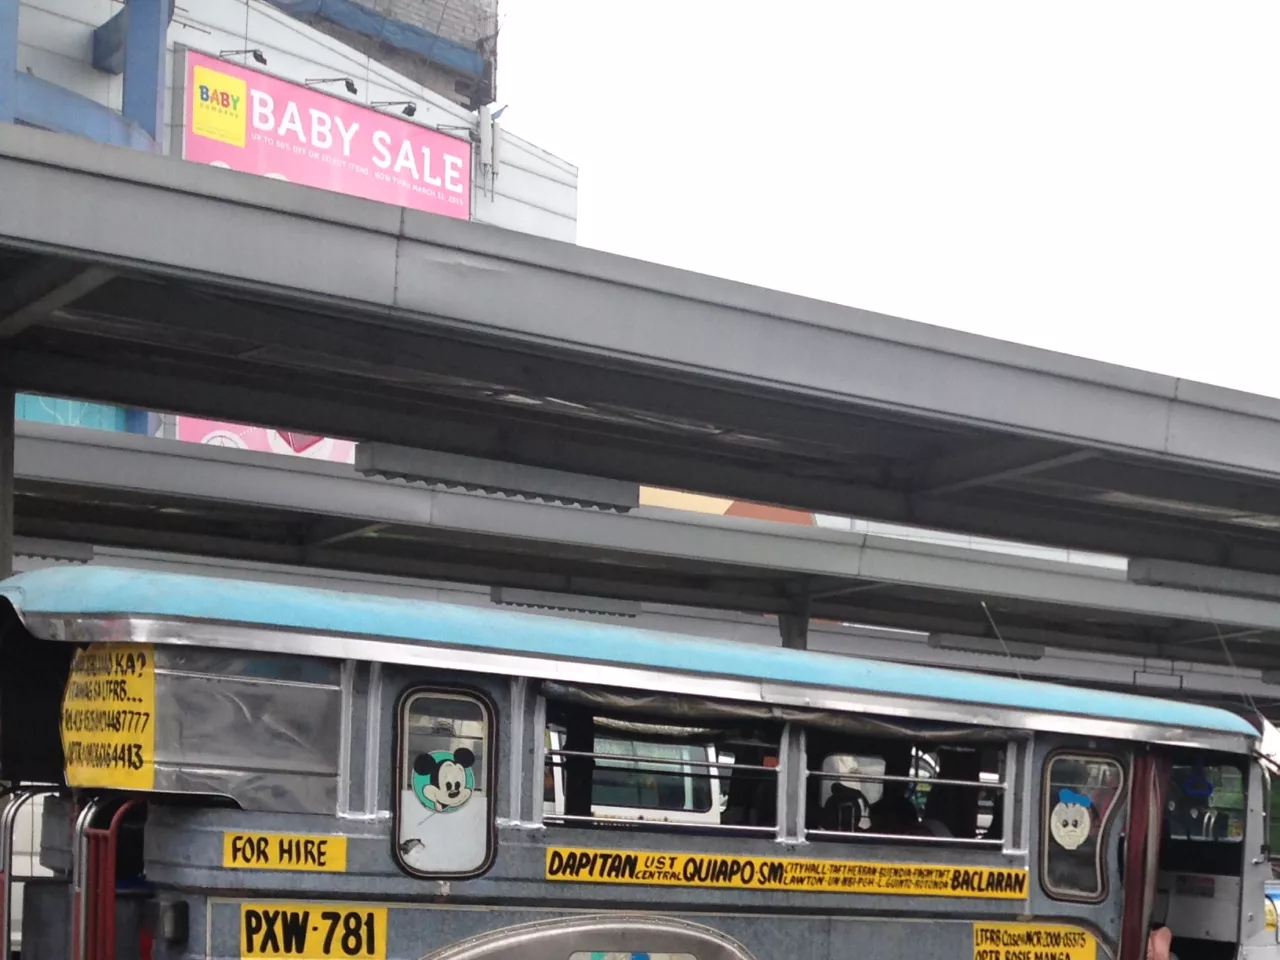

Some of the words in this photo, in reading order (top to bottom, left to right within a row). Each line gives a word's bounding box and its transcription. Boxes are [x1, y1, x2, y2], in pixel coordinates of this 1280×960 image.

[198, 85, 240, 111] BABY
[250, 88, 360, 157] BABY
[371, 130, 464, 194] SALE
[264, 136, 274, 146] TO
[292, 145, 307, 155] OFF
[411, 184, 436, 197] MARCH
[231, 836, 269, 864] FOR
[278, 839, 328, 866] HIRE
[547, 850, 638, 880] DAPITAN
[644, 856, 678, 869] UST
[634, 870, 682, 881] CENTRAL
[683, 857, 754, 884] QUIAPO
[757, 861, 784, 885] SM
[951, 869, 1026, 894] BACLARAN
